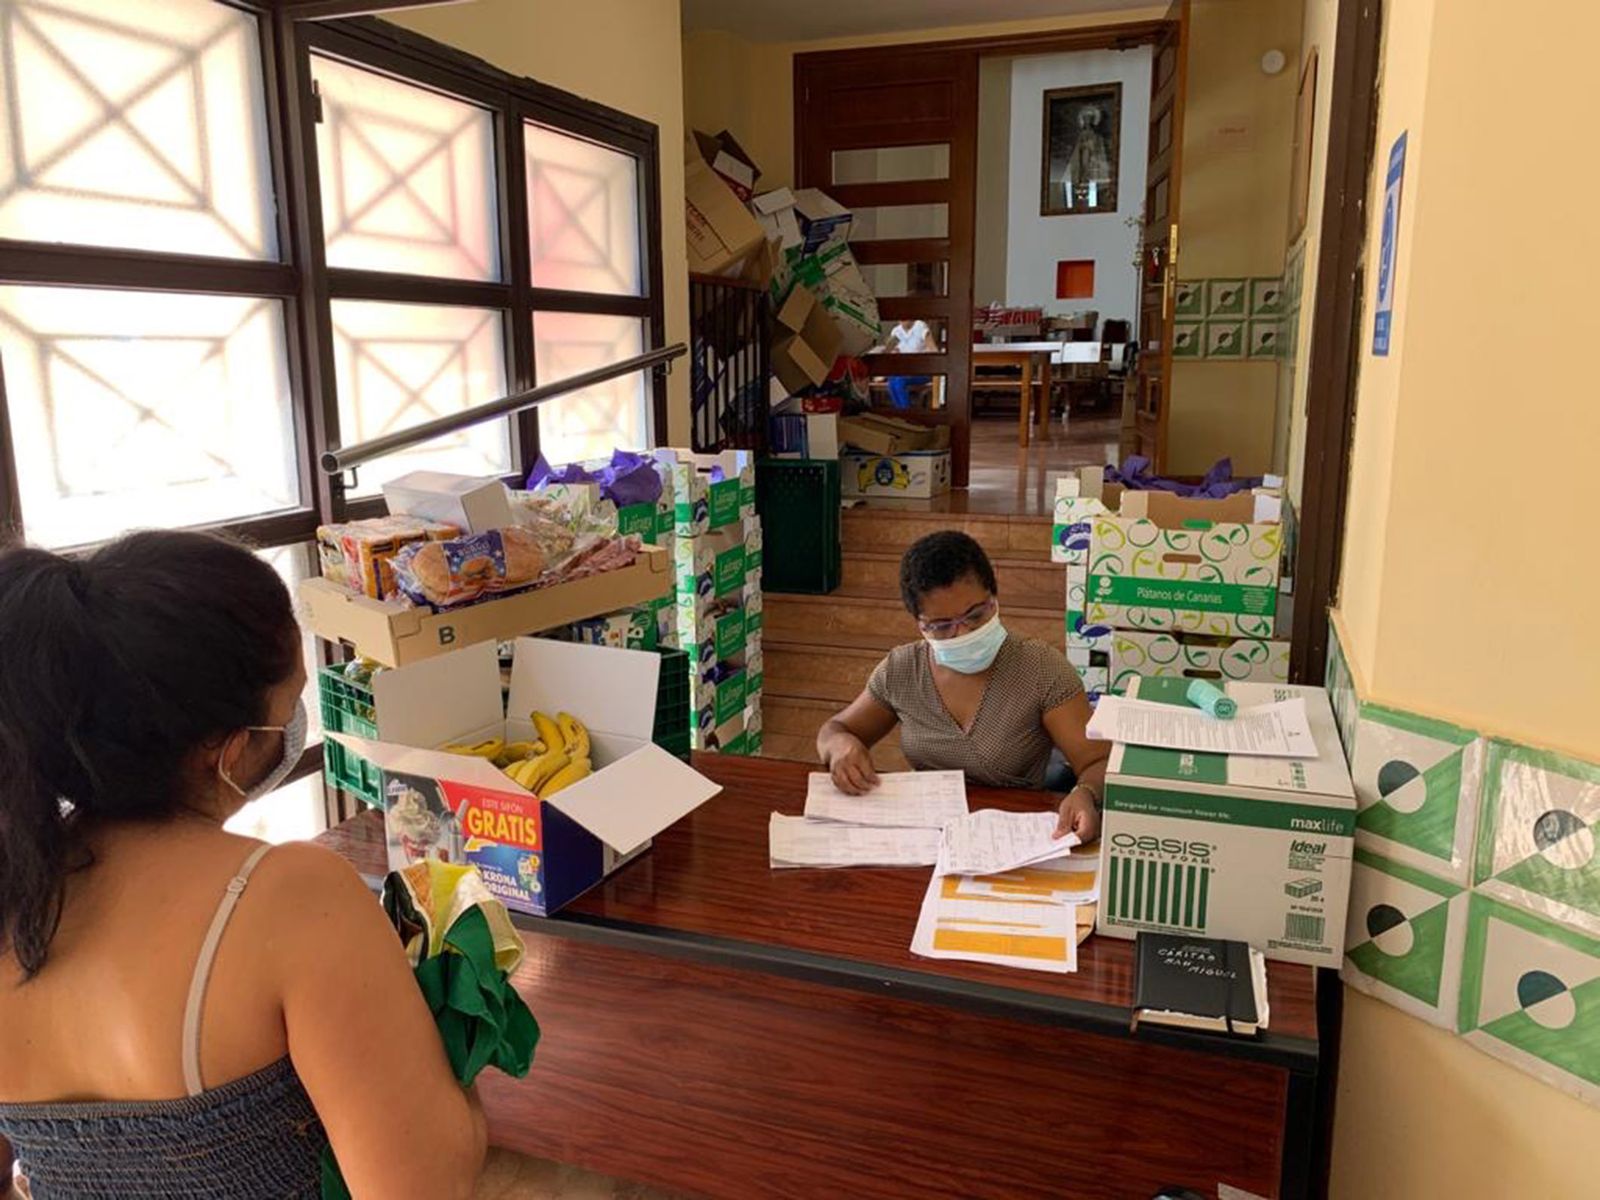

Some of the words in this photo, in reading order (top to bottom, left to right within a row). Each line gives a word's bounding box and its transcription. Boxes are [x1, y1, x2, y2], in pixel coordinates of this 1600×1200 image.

[1137, 586, 1172, 600] Plátanos
[1173, 589, 1185, 601] de
[1186, 590, 1222, 604] Canarias
[439, 626, 456, 645] B
[482, 798, 500, 810] ESTE
[468, 806, 537, 846] GRATIS
[1290, 817, 1344, 834] maxlife
[1110, 846, 1163, 859] FLORAL
[1171, 854, 1210, 865] FOAM
[1290, 840, 1327, 855] Ideal
